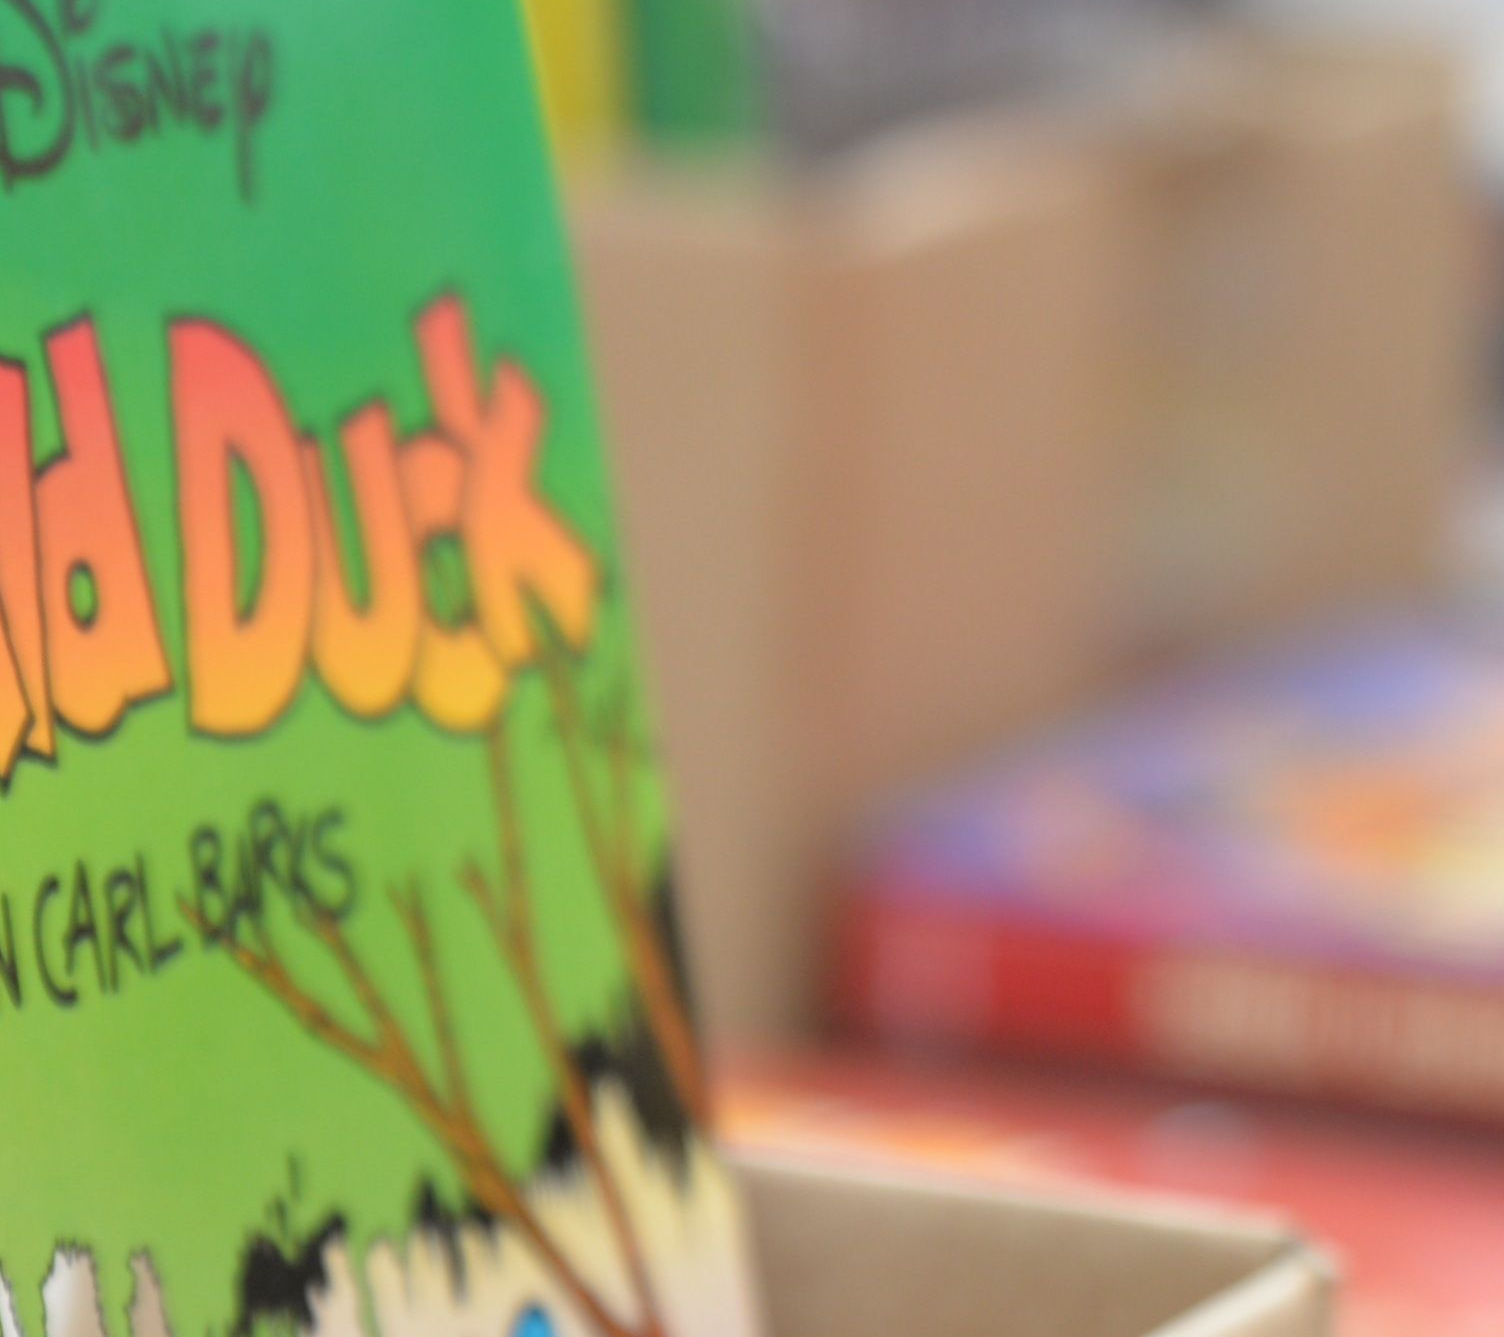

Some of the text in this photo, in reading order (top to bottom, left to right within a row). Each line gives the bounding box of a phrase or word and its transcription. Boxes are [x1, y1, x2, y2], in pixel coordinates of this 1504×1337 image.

[164, 278, 603, 746] Duck
[33, 853, 182, 1008] CARL
[184, 796, 358, 953] BARKS
